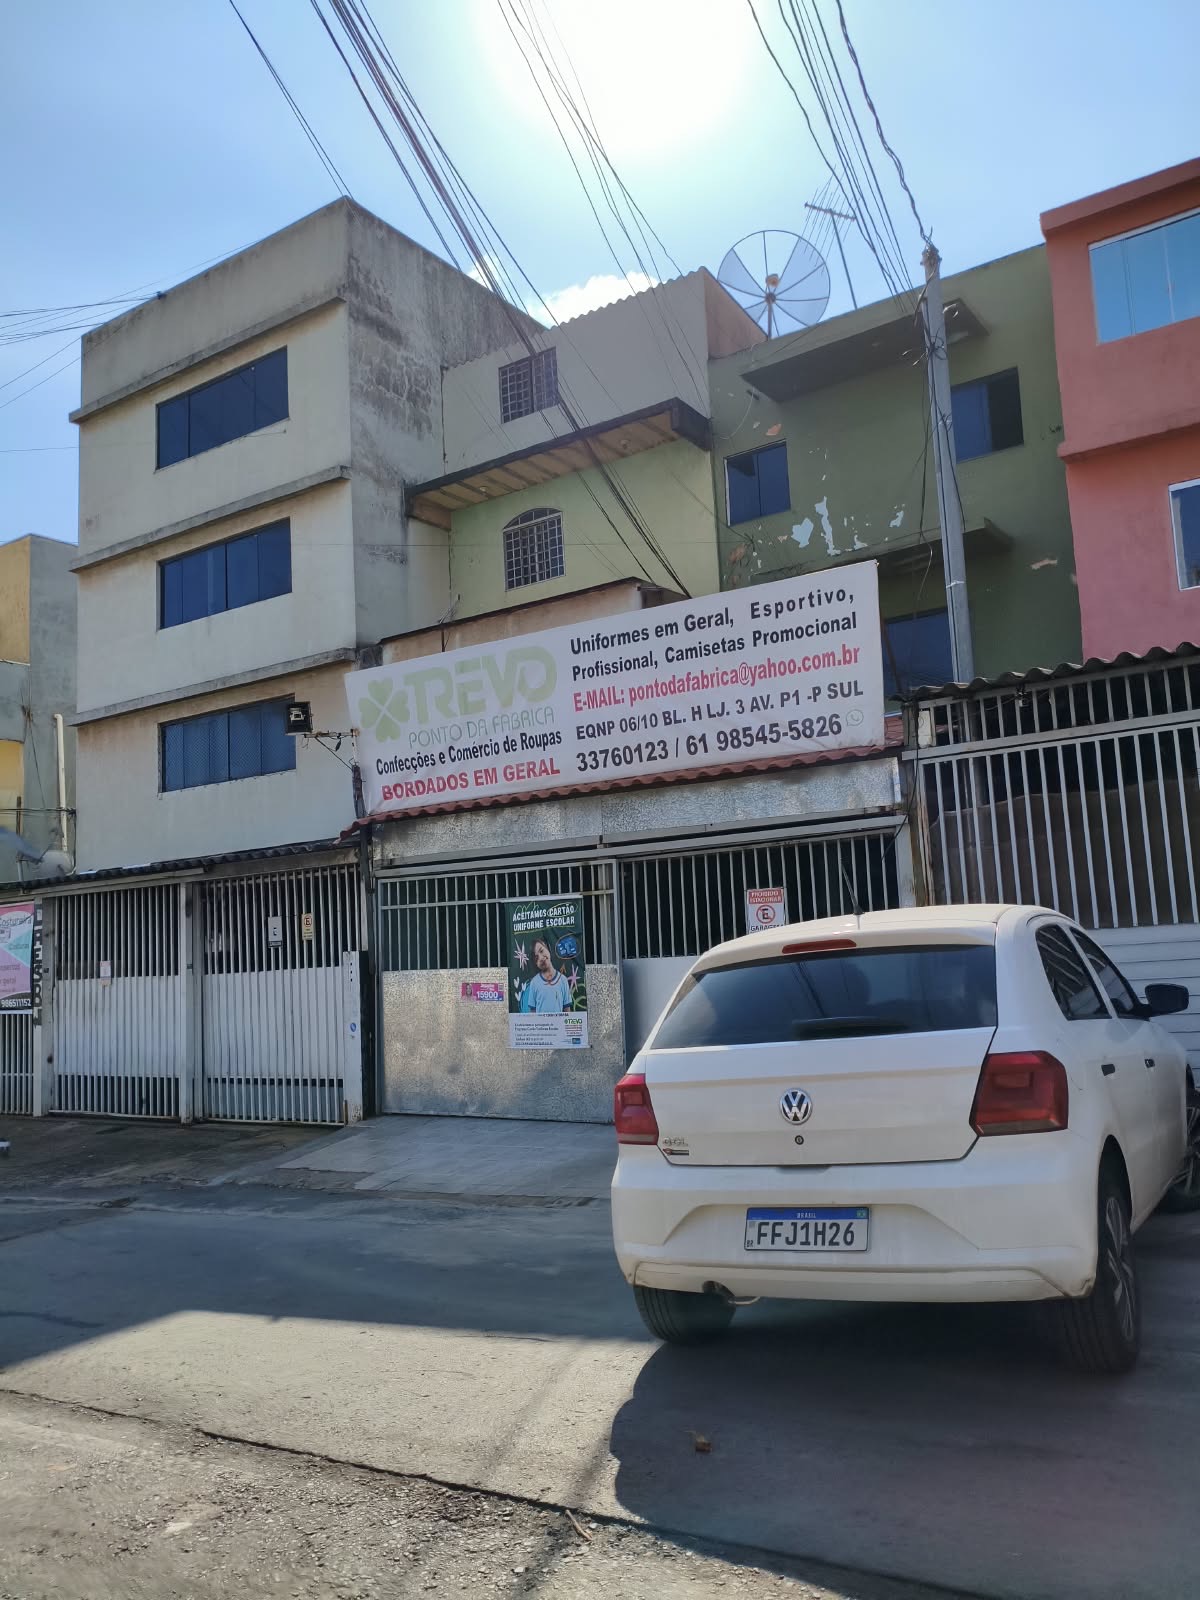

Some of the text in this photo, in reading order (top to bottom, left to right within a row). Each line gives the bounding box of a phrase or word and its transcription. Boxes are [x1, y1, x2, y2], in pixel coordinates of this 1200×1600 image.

[570, 587, 854, 655] Uniformes em Geral, Esportivo,
[572, 611, 857, 681] Profissional, Camisetas Promocional
[404, 646, 558, 724] TREVO
[573, 643, 860, 712] E-MAIL: pontodafabrica@yahoo.com.br
[408, 705, 555, 749] PONTO DA FABRICA
[576, 716, 616, 740] EQNP
[620, 711, 659, 733] 06/10
[662, 709, 687, 726] BL.
[691, 706, 702, 721] H
[707, 702, 730, 718] LJ.
[736, 699, 745, 715] 3
[750, 694, 774, 713] AV.
[780, 689, 800, 707] P1
[827, 680, 864, 700] SUL
[376, 729, 562, 776] Confecções e Comércio de Roupas
[576, 713, 842, 772] 33760123 / 61 98545-5826
[381, 757, 561, 801] BORDADOS EM GERAL
[512, 903, 575, 922] ACEITAMOS CARTÃO
[513, 916, 575, 932] UNIFORME ESCOLAR
[757, 1221, 855, 1246] FFJ1H26
